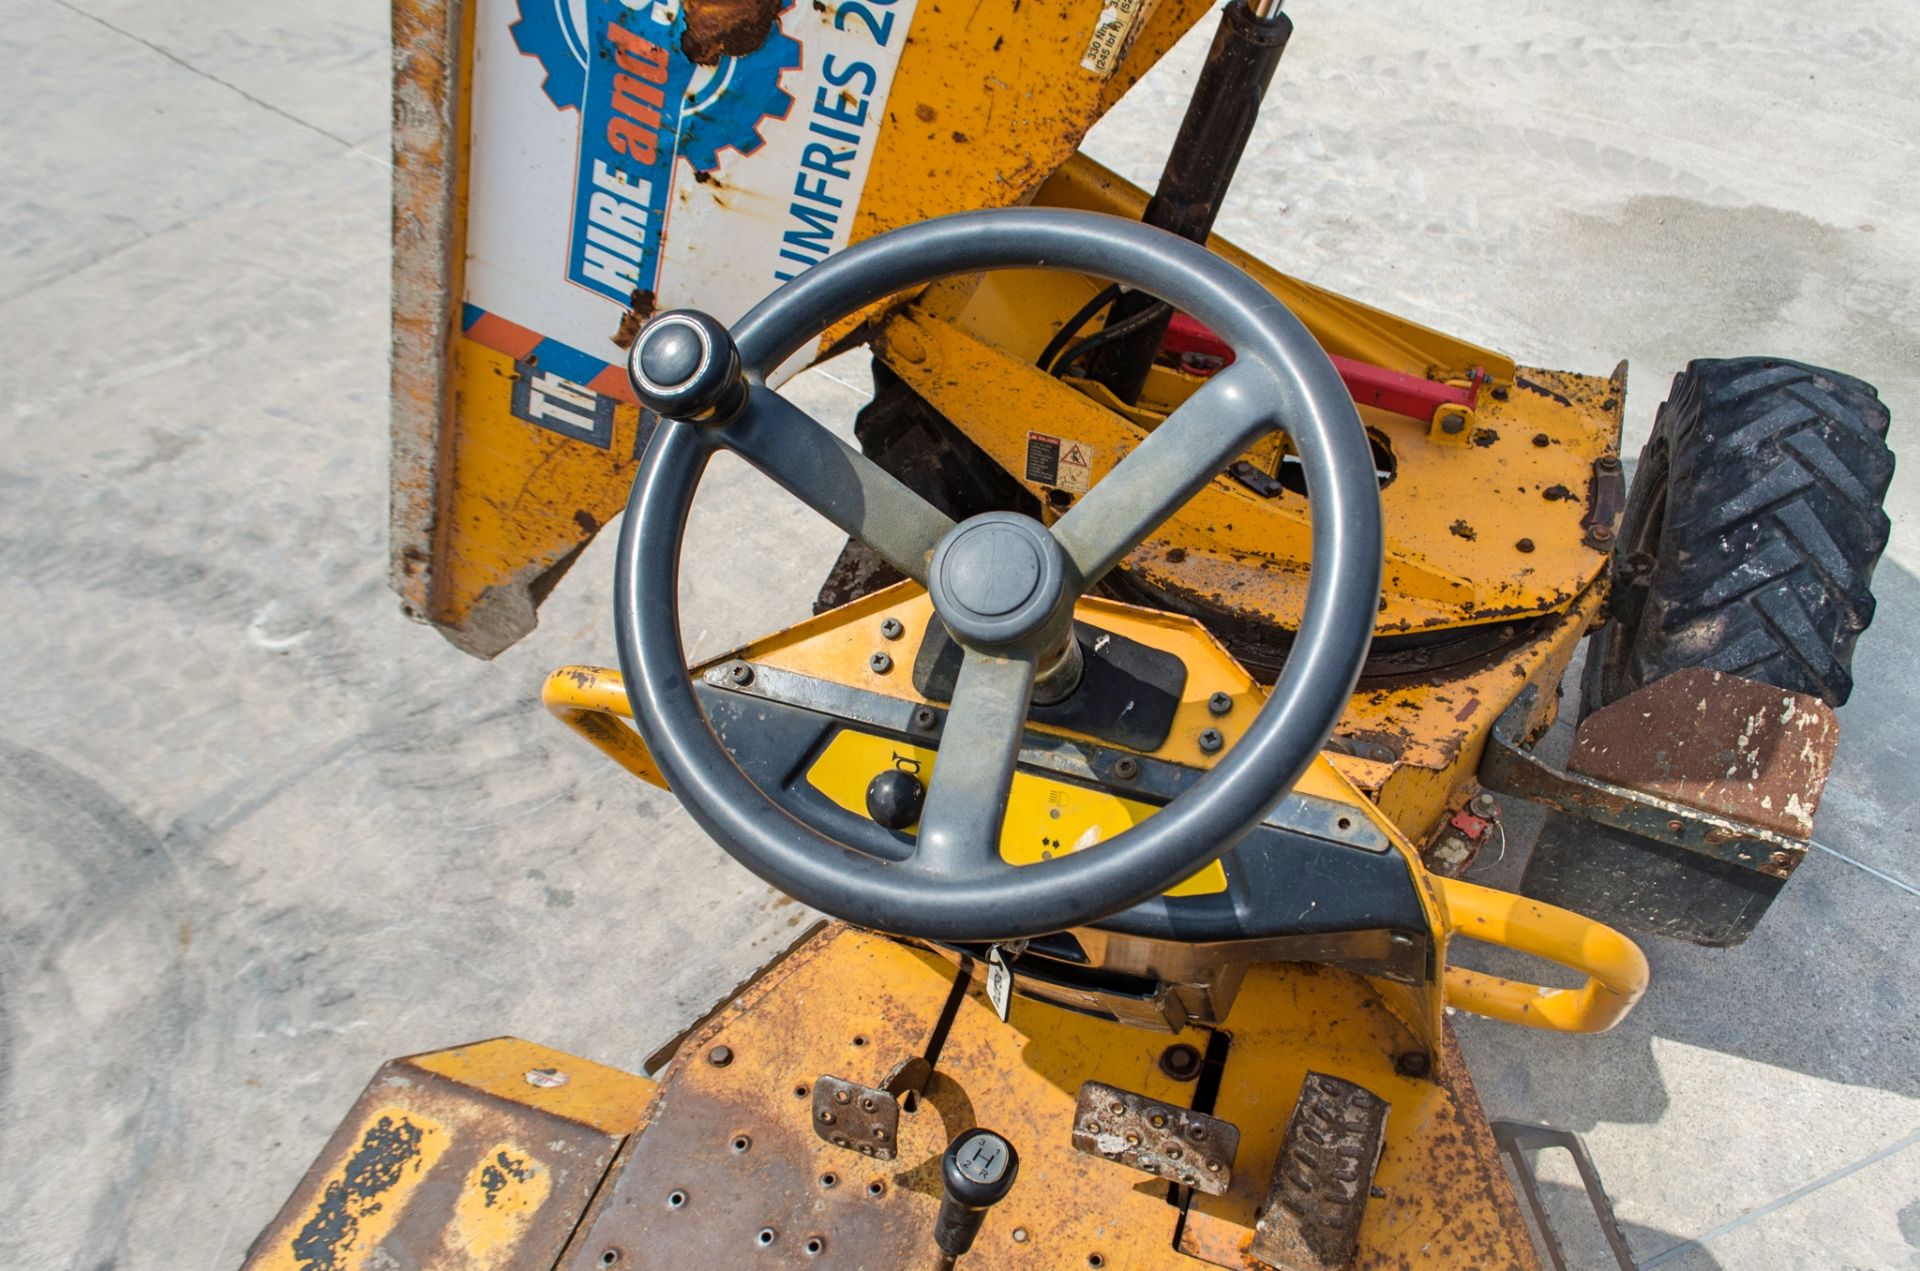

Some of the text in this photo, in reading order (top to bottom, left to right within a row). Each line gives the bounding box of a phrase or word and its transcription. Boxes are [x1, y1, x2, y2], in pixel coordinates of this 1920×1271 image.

[835, 0, 902, 47] 2
[1088, 23, 1108, 59] 330 Nm
[1096, 49, 1110, 70] (245
[1105, 32, 1117, 47] lbf
[607, 21, 669, 165] and
[582, 159, 652, 297] HIRE
[962, 1160, 972, 1169] 2
[978, 1168, 989, 1179] R
